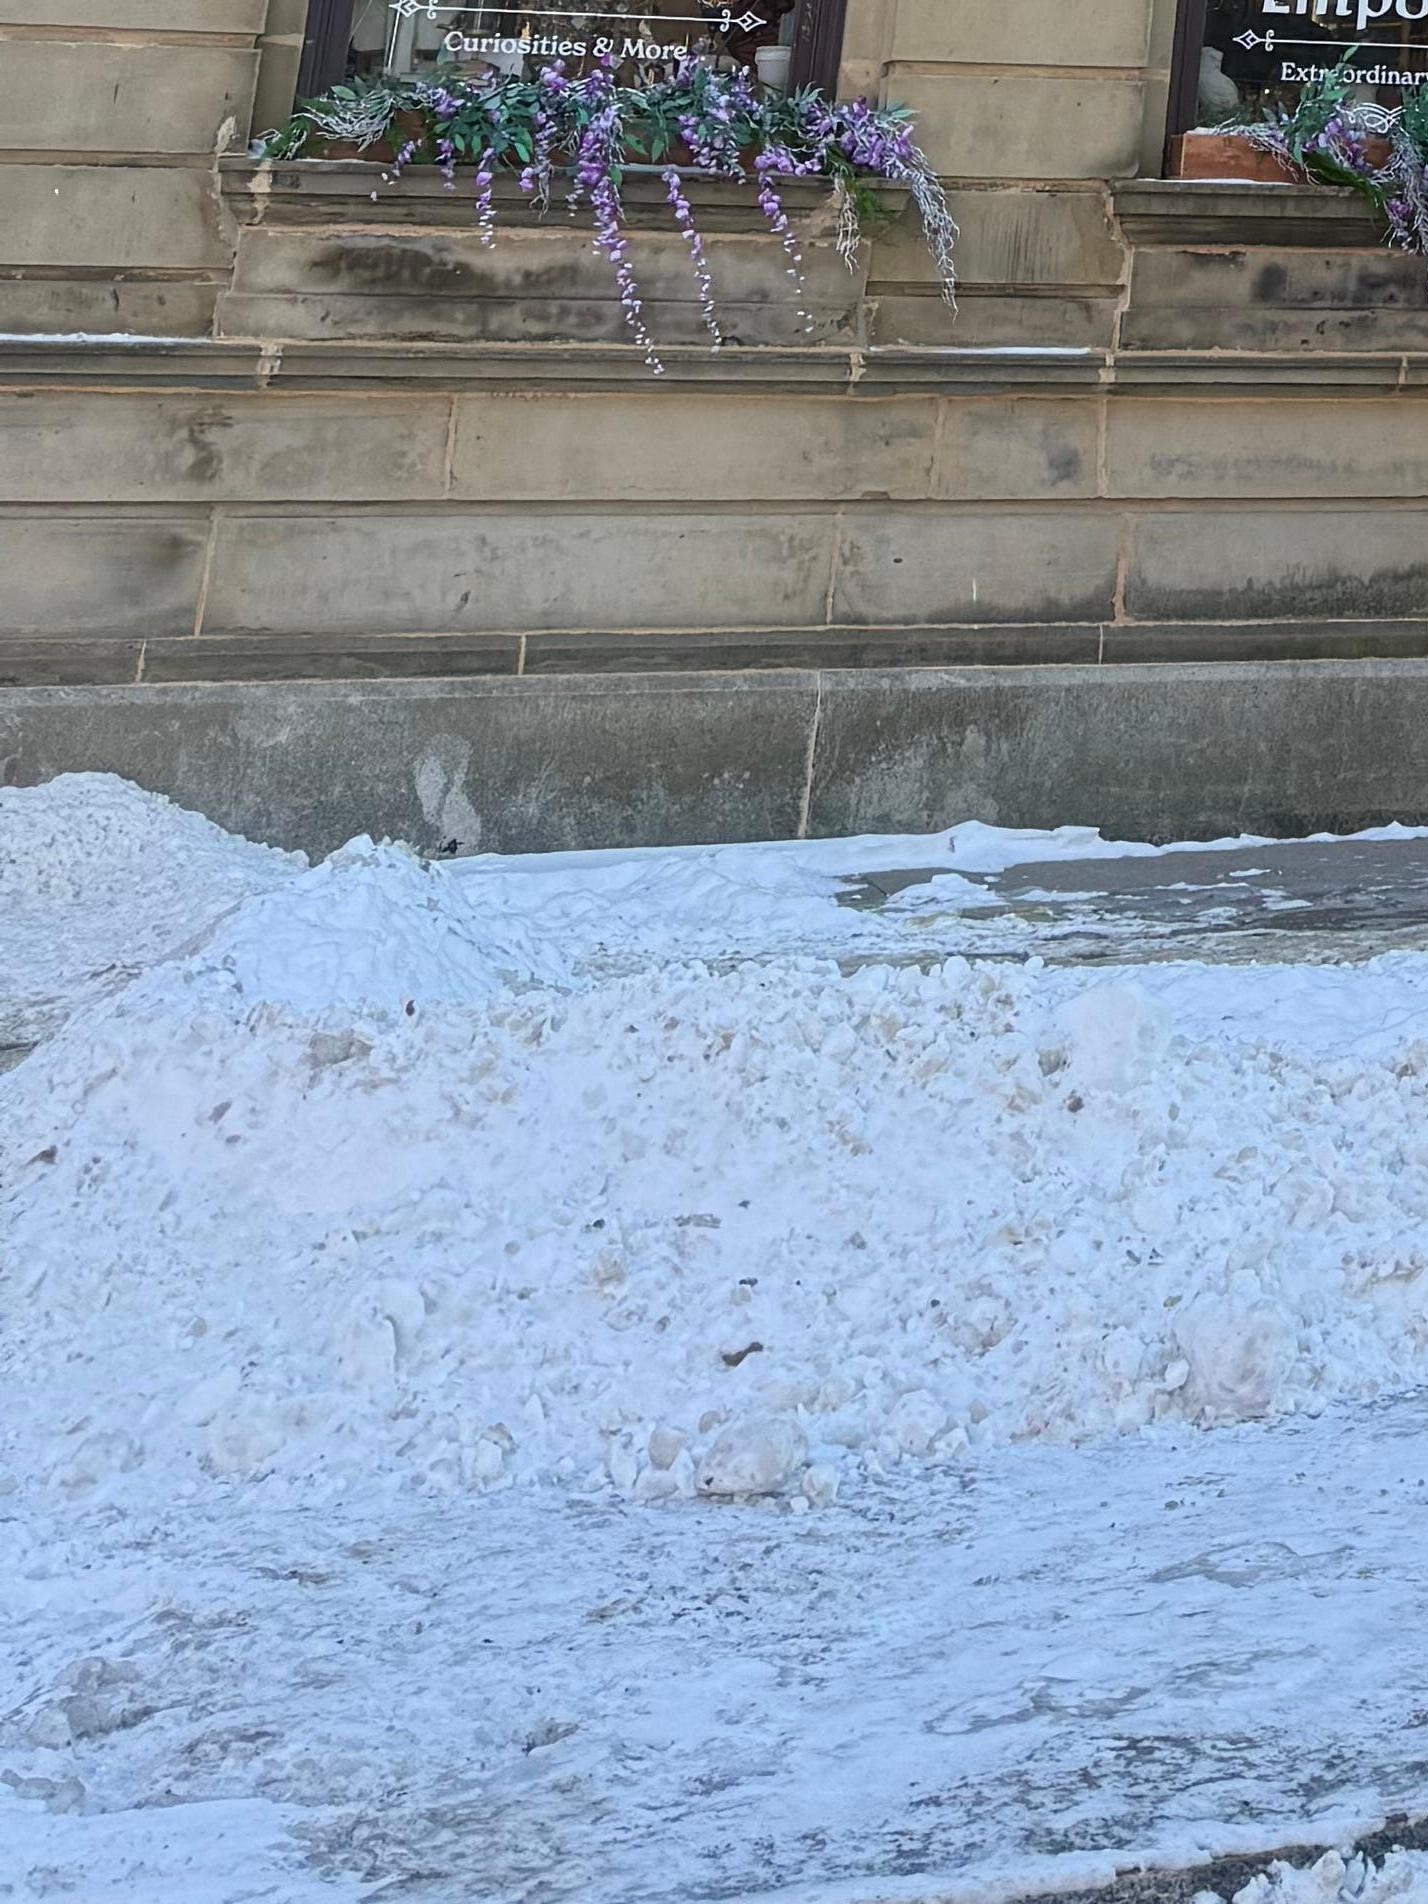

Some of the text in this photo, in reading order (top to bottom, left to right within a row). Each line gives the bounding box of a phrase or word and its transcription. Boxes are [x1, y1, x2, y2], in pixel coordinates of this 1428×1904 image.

[443, 31, 688, 60] Curiosities & More
